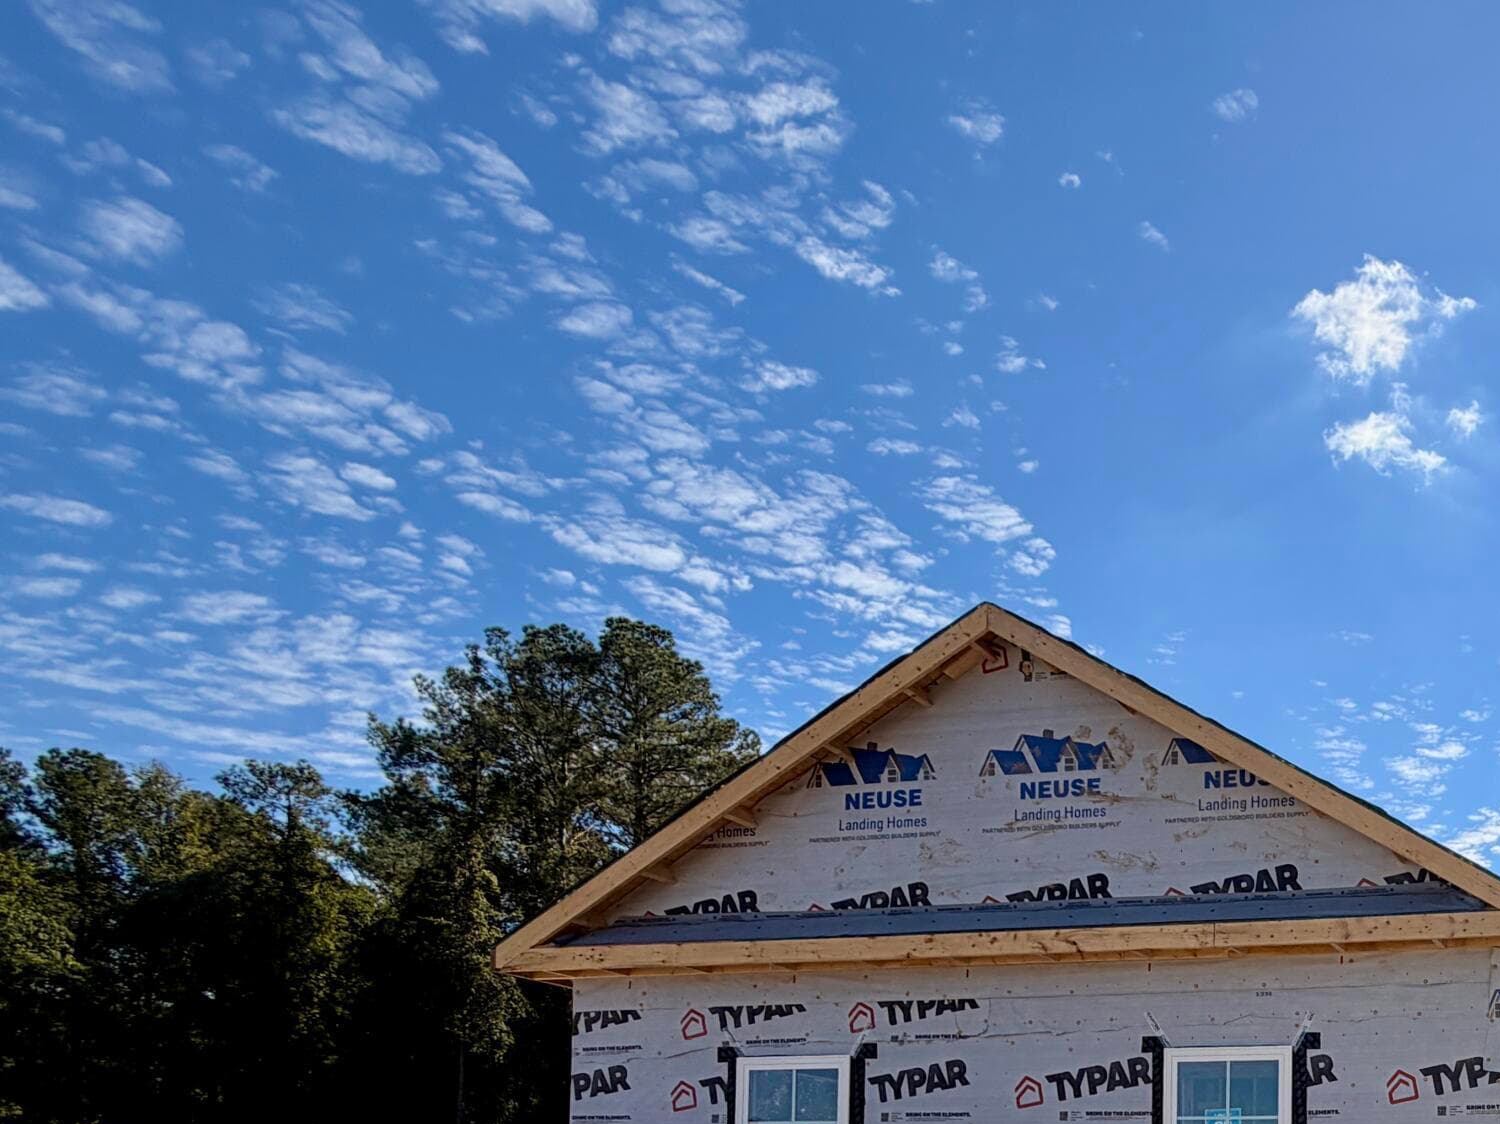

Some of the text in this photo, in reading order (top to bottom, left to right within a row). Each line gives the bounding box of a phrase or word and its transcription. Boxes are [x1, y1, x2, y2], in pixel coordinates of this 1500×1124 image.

[1020, 778, 1101, 800] NEUSE
[1204, 769, 1270, 789] NEU
[845, 789, 922, 811] NEUSE
[1198, 796, 1295, 812] Landing Homes
[839, 816, 927, 832] Landing Homes
[1014, 806, 1106, 822] Landing Homes
[717, 826, 756, 839] Homes
[664, 890, 760, 915] PAR
[831, 882, 932, 910] PAR
[571, 1065, 631, 1101] PAR
[868, 1059, 970, 1103] TYPAR
[1045, 1057, 1152, 1101] TYPAR
